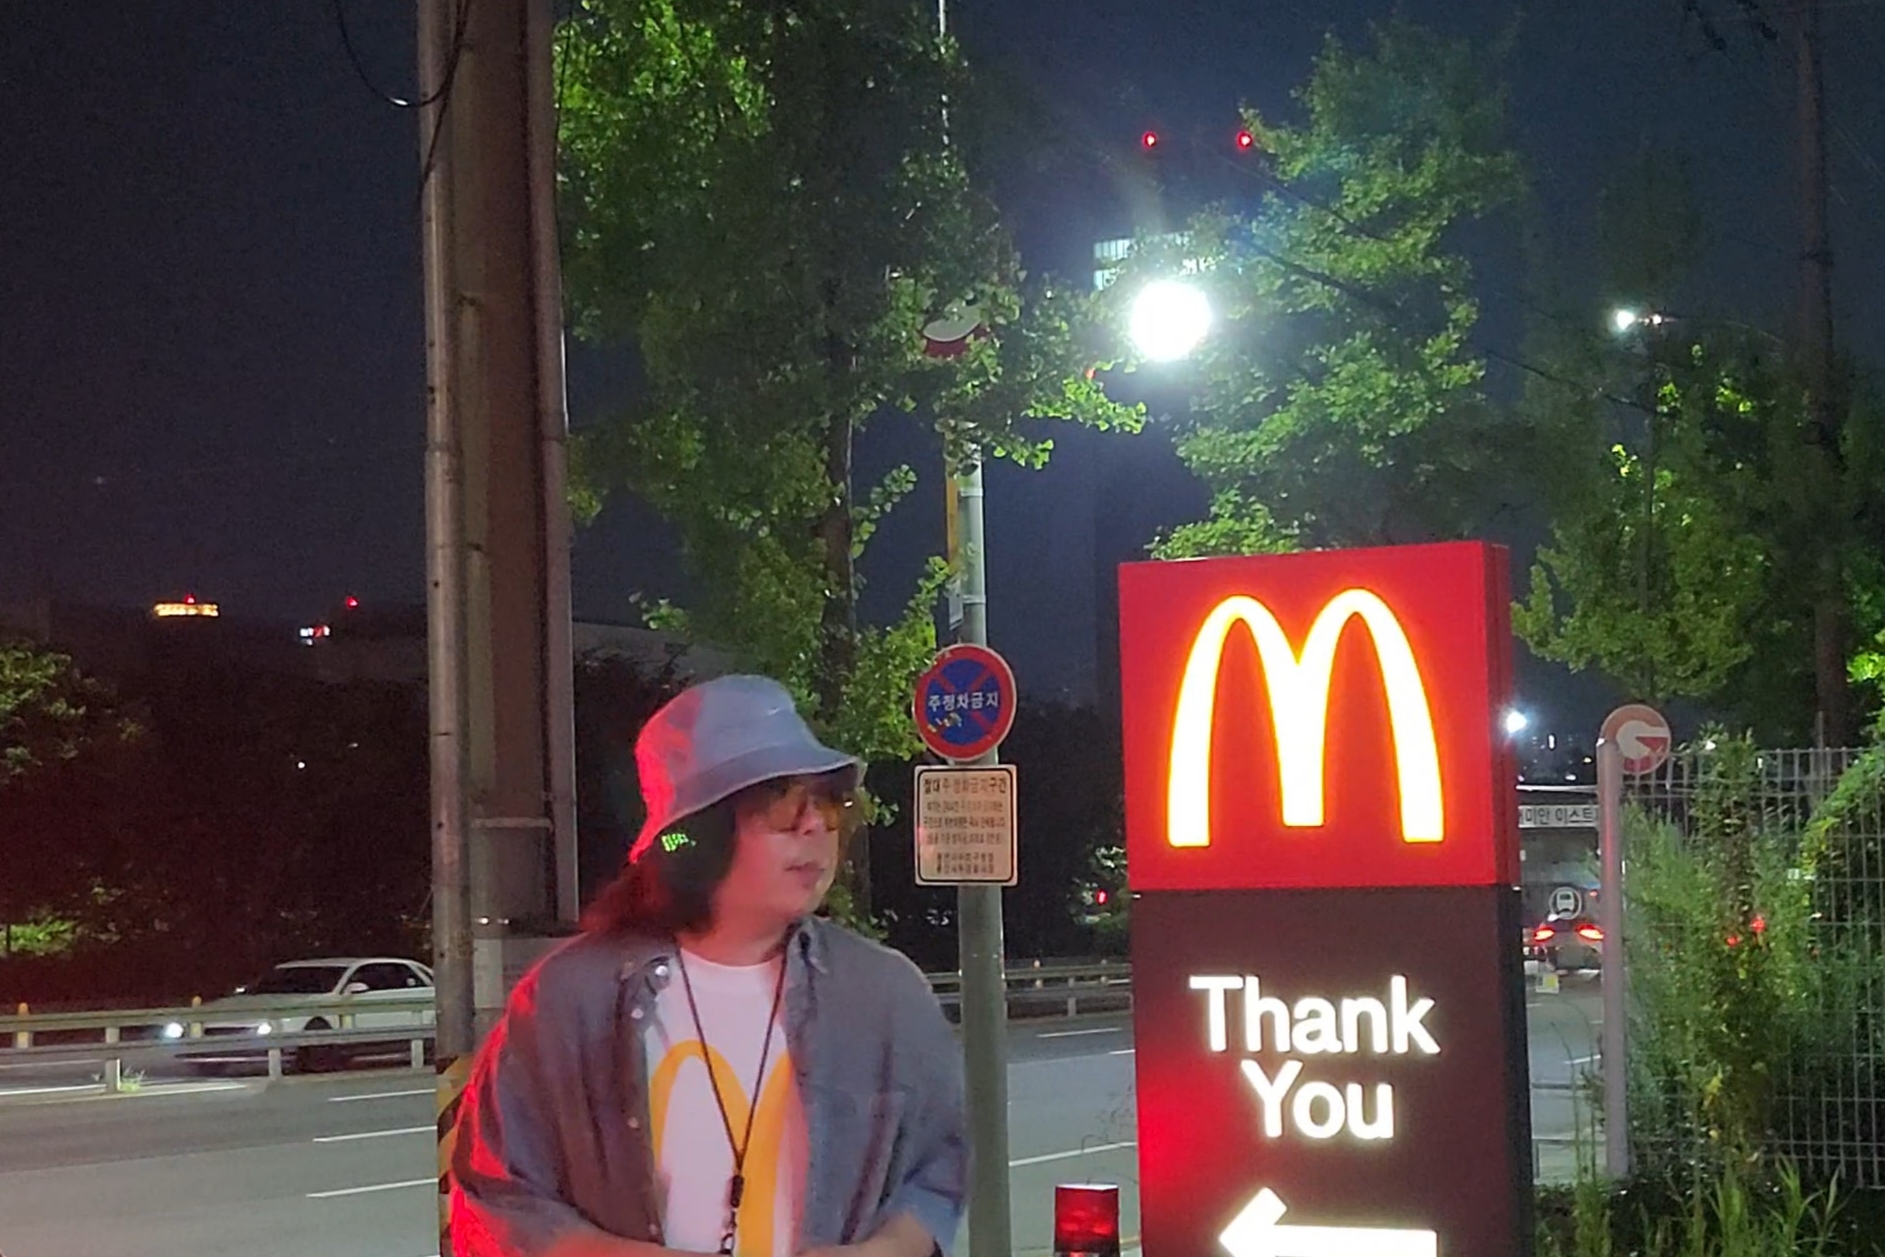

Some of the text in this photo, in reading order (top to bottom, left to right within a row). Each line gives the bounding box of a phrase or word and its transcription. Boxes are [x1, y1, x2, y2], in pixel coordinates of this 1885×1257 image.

[928, 691, 998, 712] 주정차금지
[1519, 807, 1598, 825] 미안 이스트
[1189, 973, 1441, 1056] Thank
[1240, 1058, 1396, 1141] You
